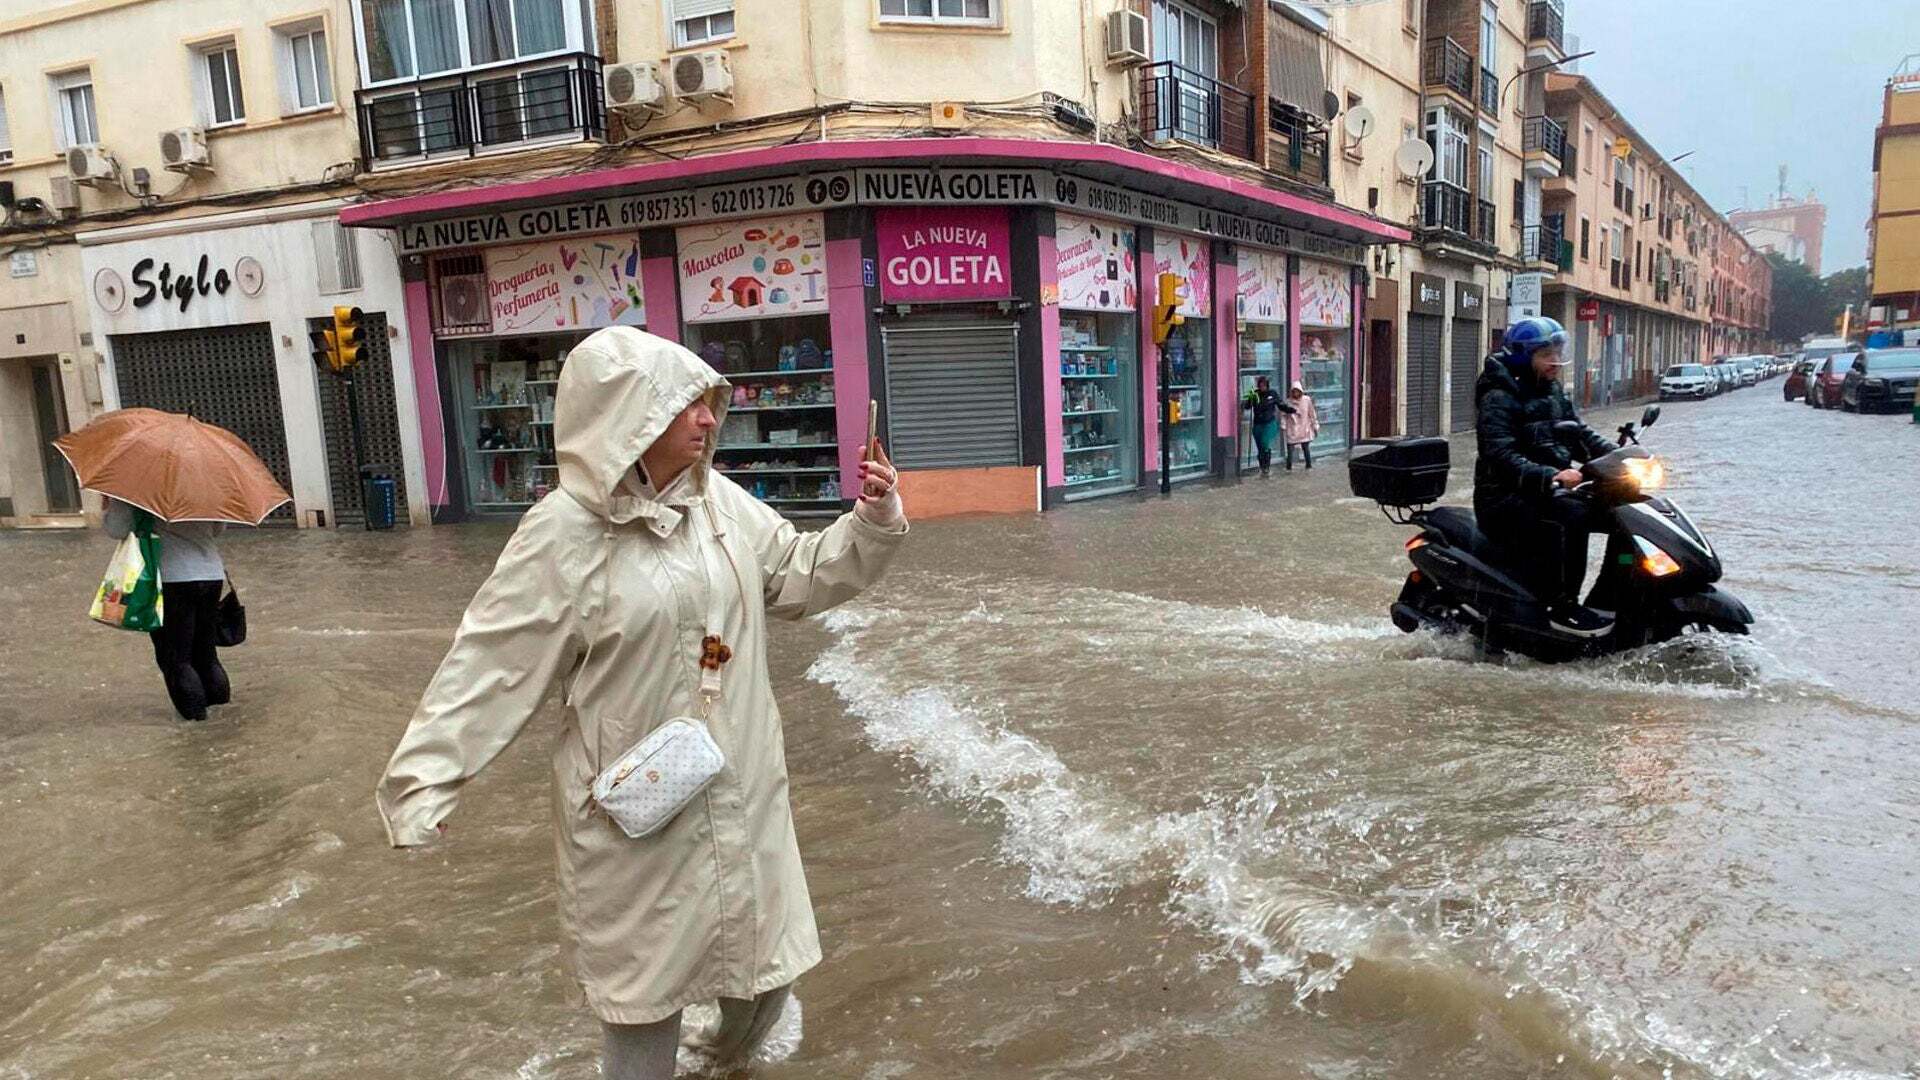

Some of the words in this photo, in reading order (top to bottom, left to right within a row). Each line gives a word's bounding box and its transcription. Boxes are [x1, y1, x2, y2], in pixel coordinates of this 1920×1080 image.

[865, 174, 945, 199] NUEVA
[950, 174, 1037, 199] GOLETA
[402, 226, 429, 250] LA
[434, 216, 510, 246] NUEVA
[518, 203, 612, 237] GOLETA
[902, 230, 926, 250] LA
[929, 227, 988, 249] NUEVA
[1198, 210, 1213, 233] LA
[1217, 214, 1250, 240] NUEVA
[1255, 222, 1290, 247] GOLETA
[683, 243, 745, 278] Mascotas
[887, 255, 1003, 286] GOLETA
[131, 254, 231, 313] Stylo
